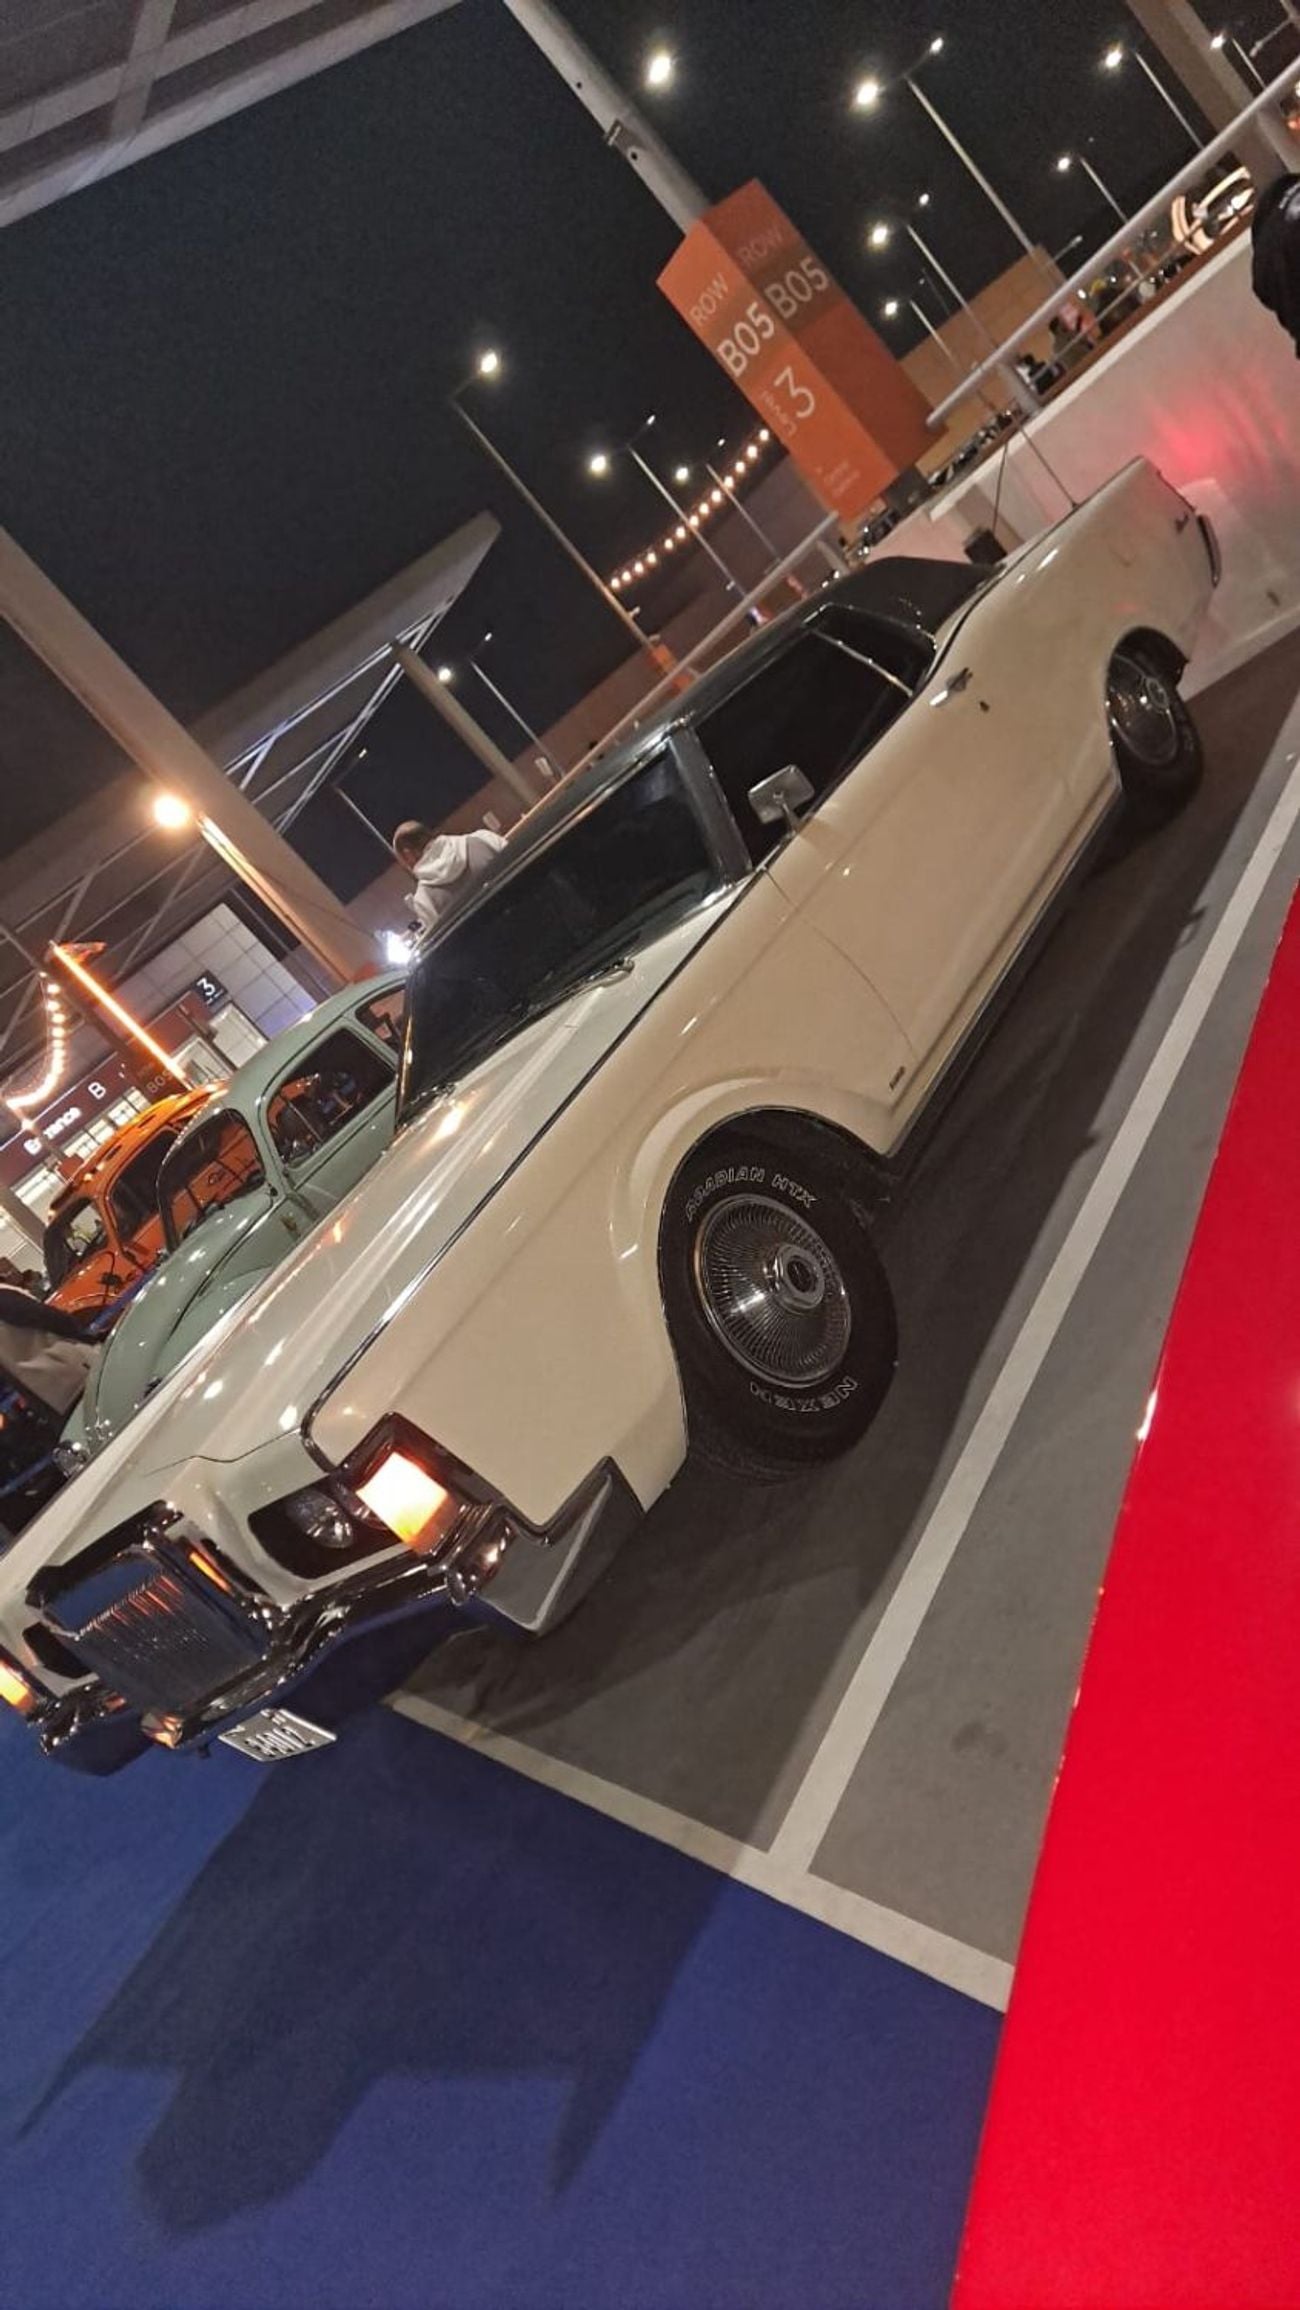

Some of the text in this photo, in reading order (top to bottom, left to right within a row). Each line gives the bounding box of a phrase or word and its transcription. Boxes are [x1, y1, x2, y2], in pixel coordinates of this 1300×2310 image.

[740, 228, 784, 266] ROW
[690, 272, 729, 325] ROW
[765, 257, 829, 319] B05
[716, 302, 775, 377] B05
[774, 366, 815, 418] 3
[196, 977, 216, 997] 3
[87, 1081, 107, 1100] B
[772, 1173, 818, 1210] HTX
